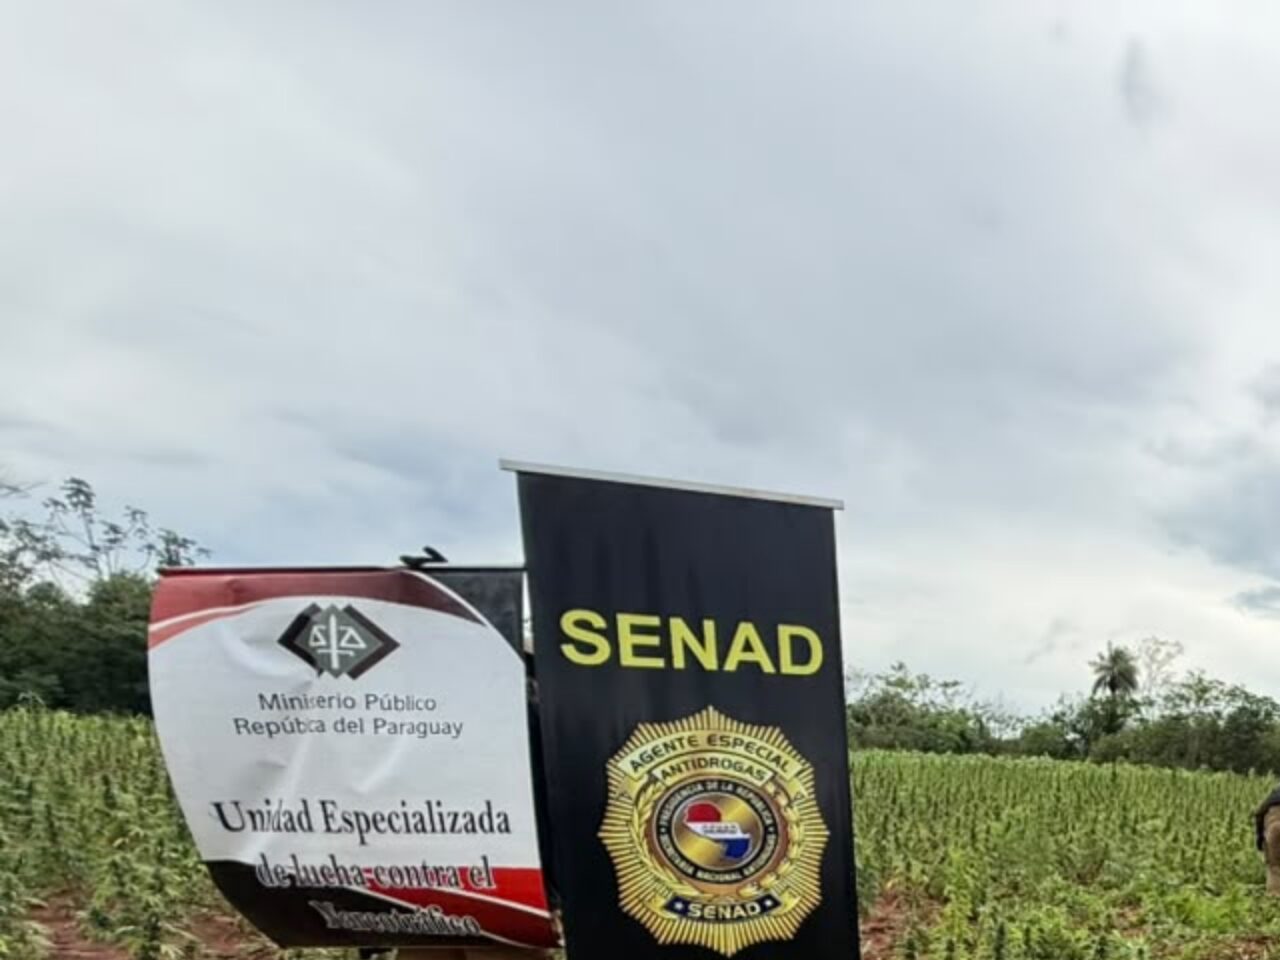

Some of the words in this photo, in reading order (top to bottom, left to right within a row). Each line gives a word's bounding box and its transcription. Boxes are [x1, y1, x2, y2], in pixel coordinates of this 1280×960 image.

[559, 608, 824, 676] SENAD
[365, 693, 437, 711] Público
[333, 717, 364, 734] del
[373, 717, 463, 739] Paraguay
[630, 734, 699, 773] AGENTE
[707, 733, 790, 772] ESPECIAL
[660, 757, 767, 781] ANTIDROGAS
[210, 798, 314, 832] Unidad
[320, 799, 512, 845] Especializada
[256, 852, 291, 888] de
[291, 853, 367, 888] lucha
[374, 860, 462, 889] contra
[469, 854, 495, 889] el
[687, 902, 761, 919] SENAD
